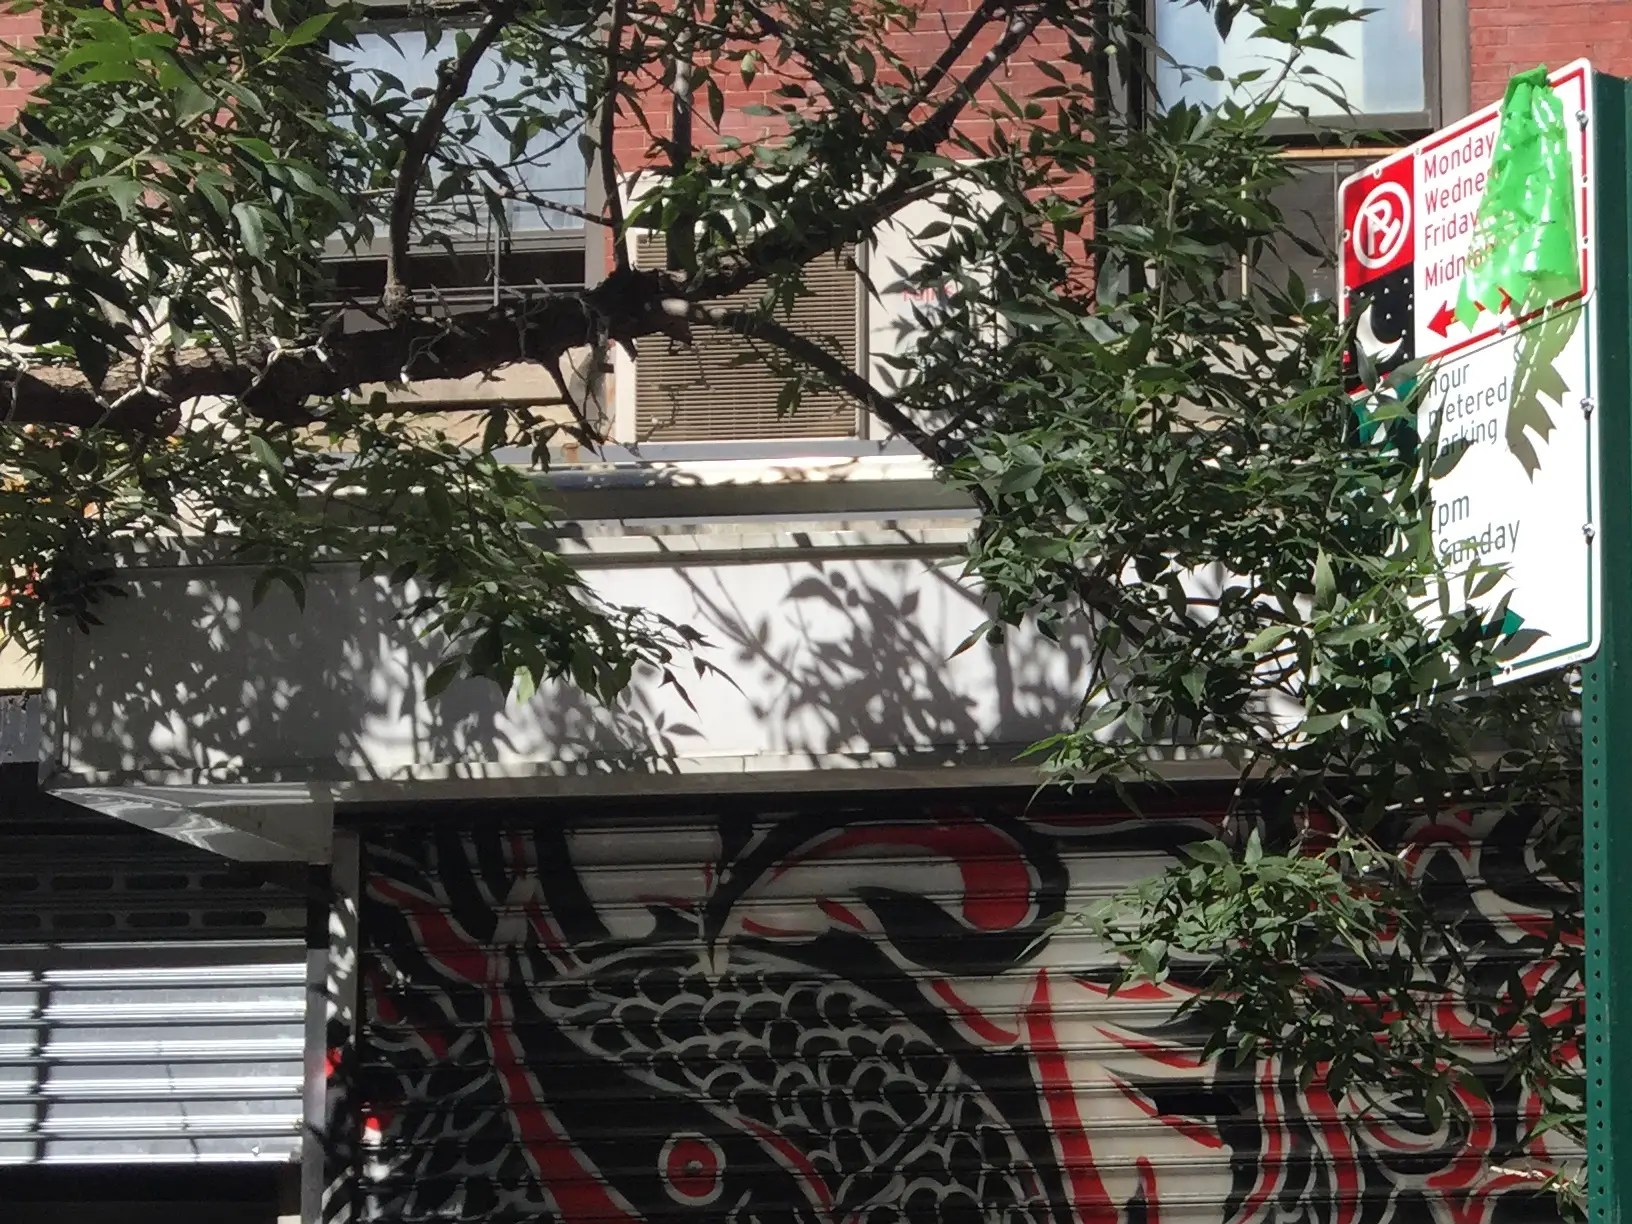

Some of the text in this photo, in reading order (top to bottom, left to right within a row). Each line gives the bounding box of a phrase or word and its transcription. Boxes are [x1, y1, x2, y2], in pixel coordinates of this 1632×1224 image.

[1424, 131, 1496, 184] Monday
[1425, 171, 1489, 215] Wedne
[1425, 208, 1479, 251] Friday
[1438, 495, 1470, 535] pm
